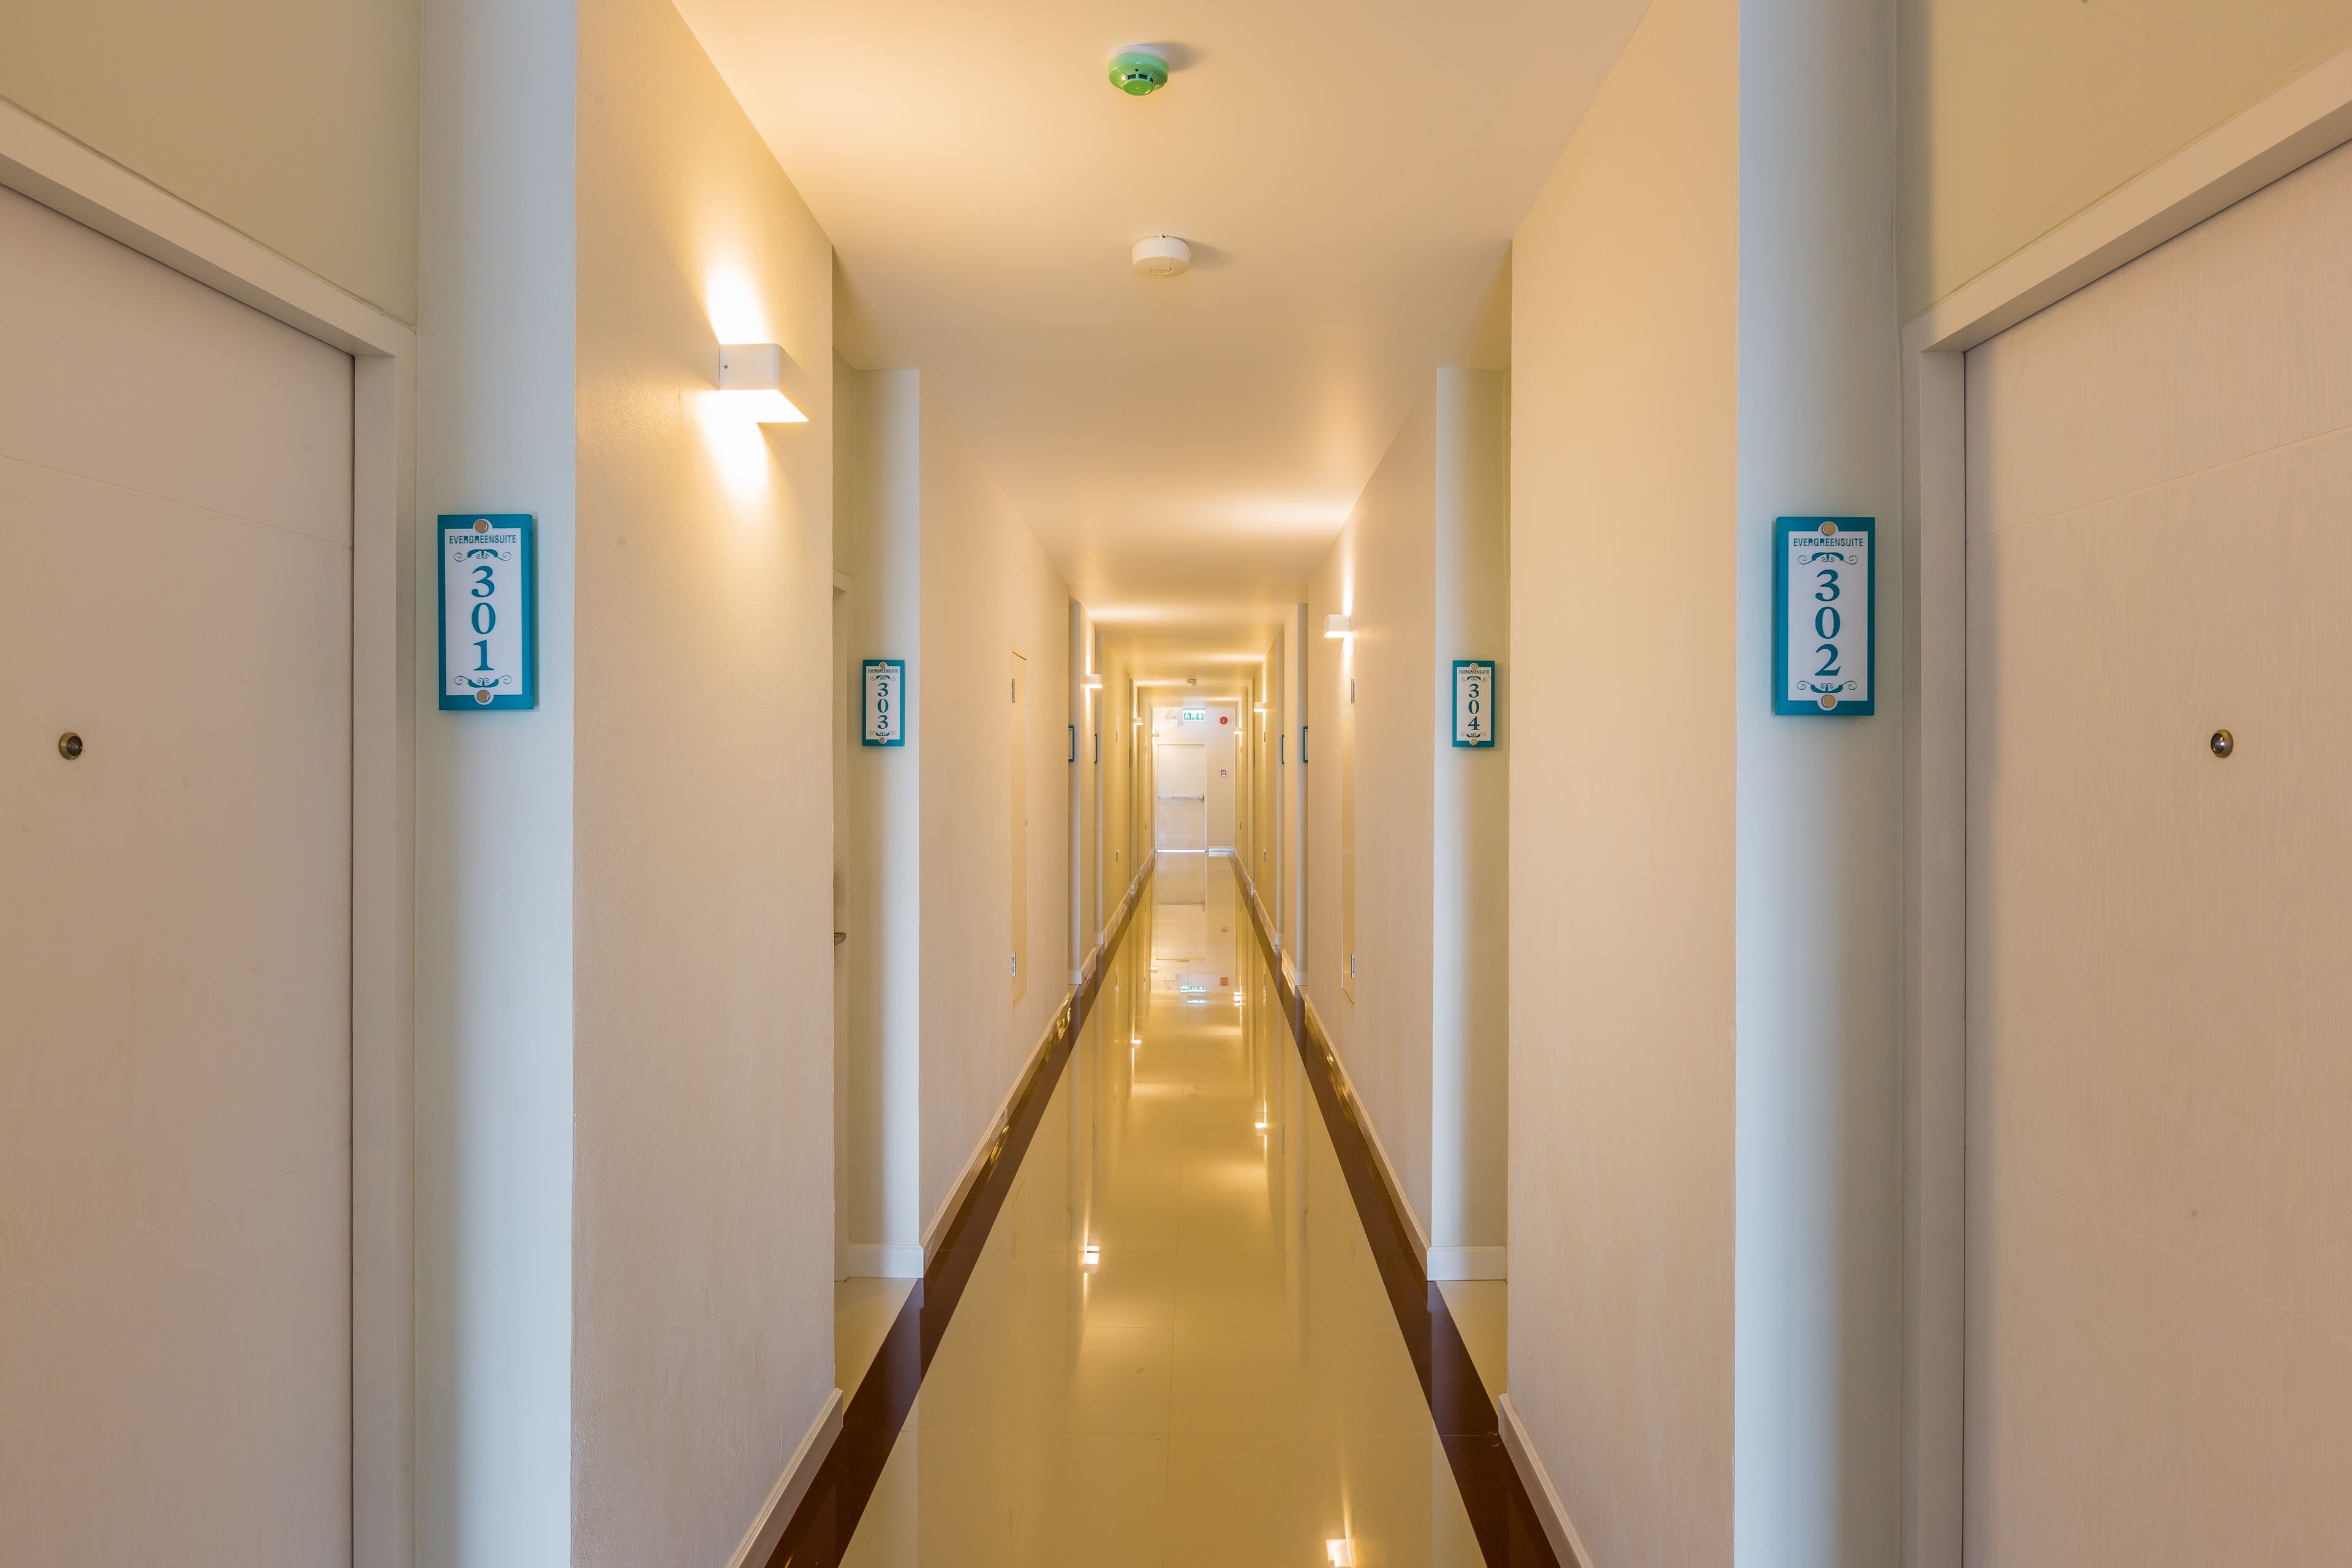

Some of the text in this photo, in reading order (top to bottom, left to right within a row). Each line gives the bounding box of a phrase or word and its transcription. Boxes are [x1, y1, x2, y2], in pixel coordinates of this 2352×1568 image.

[449, 535, 517, 544] EVERGREENSUITE
[1793, 538, 1864, 547] EVERGREENSUITE
[471, 565, 496, 671] 301
[1814, 569, 1841, 676] 302
[877, 682, 889, 729] 303
[1468, 684, 1480, 731] 304
